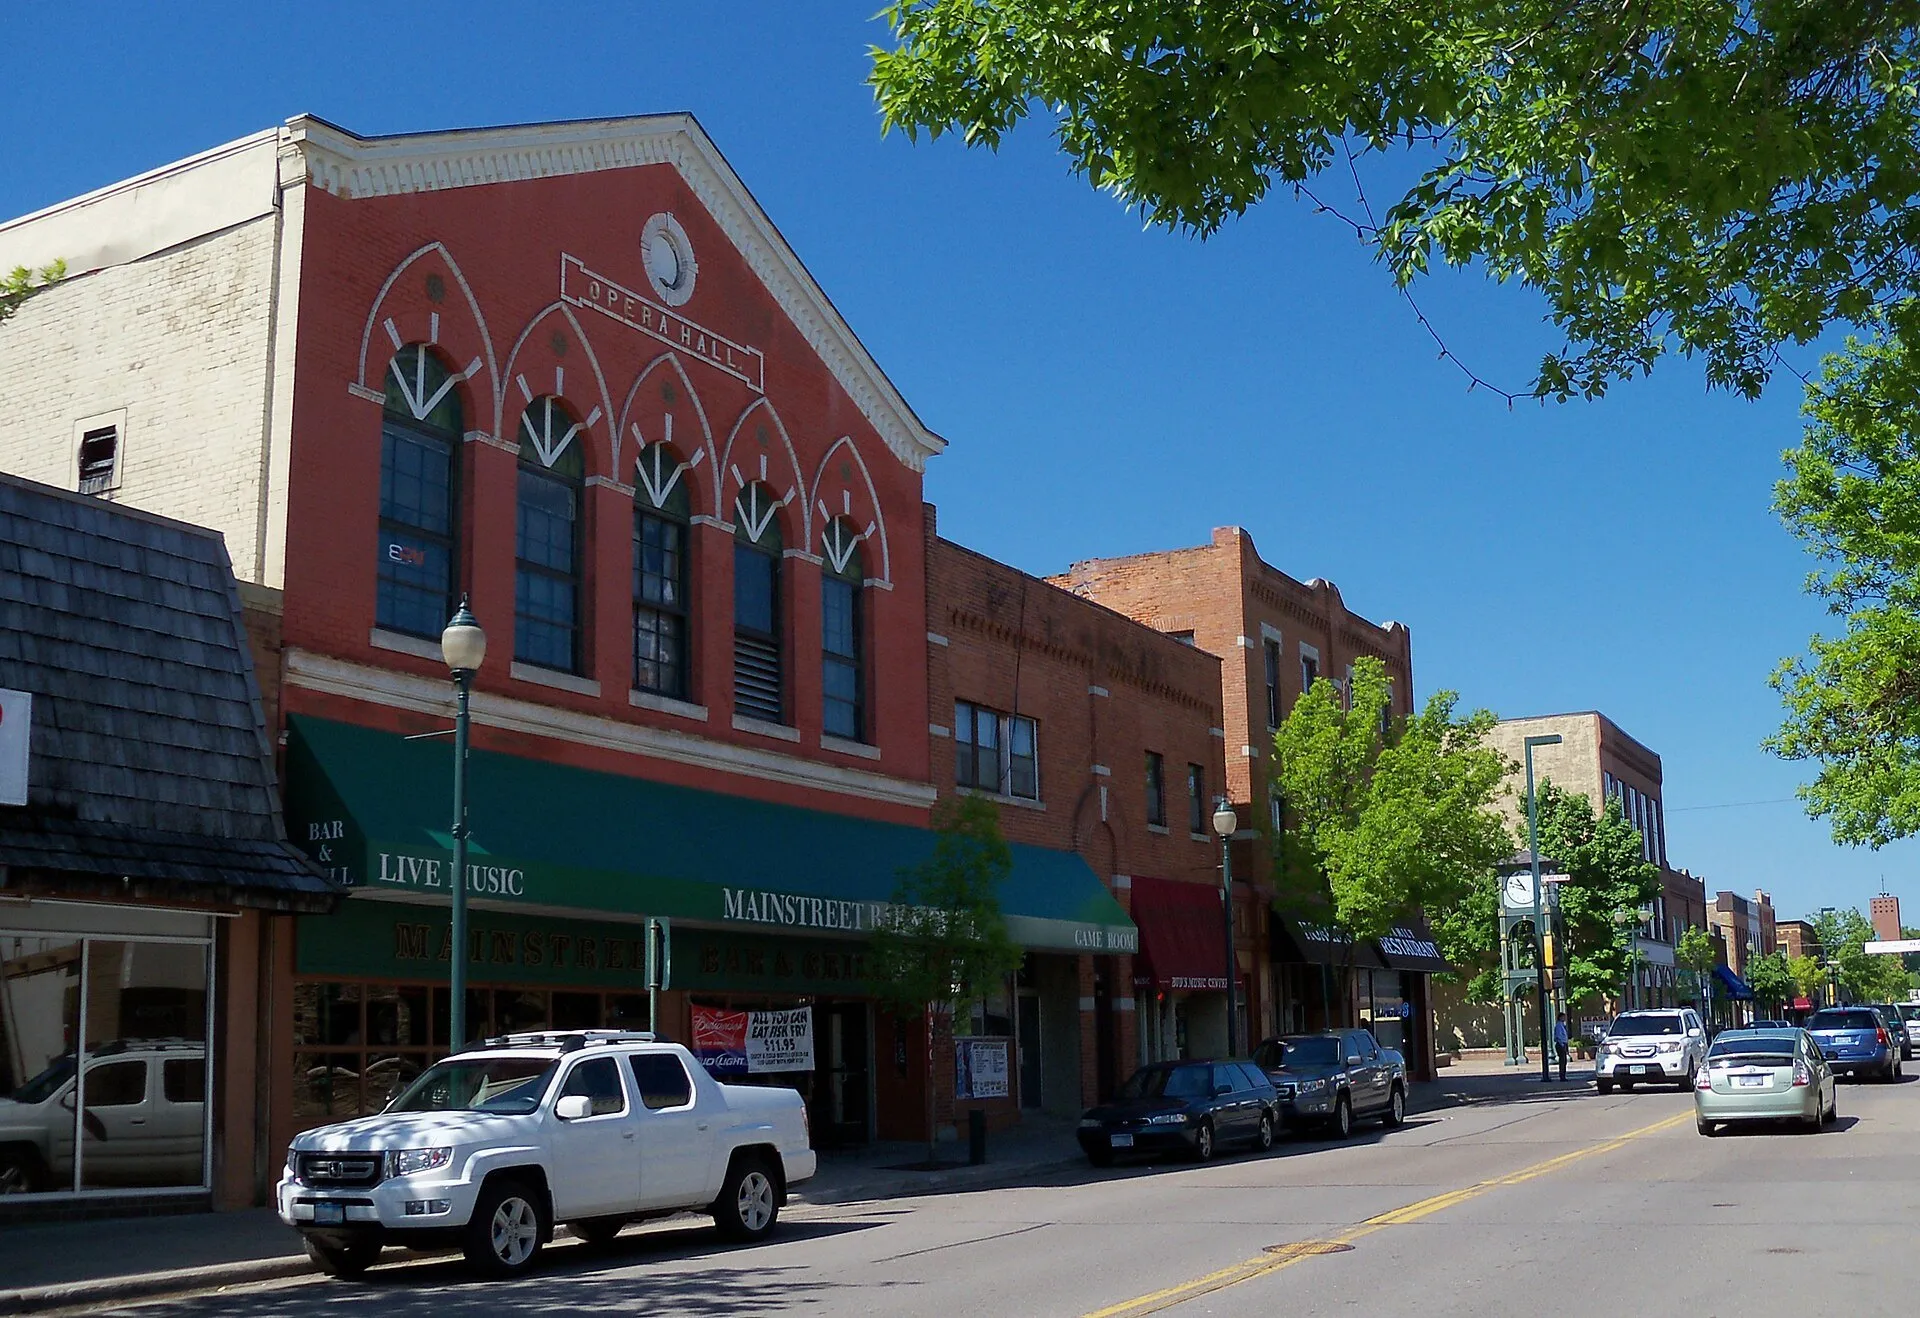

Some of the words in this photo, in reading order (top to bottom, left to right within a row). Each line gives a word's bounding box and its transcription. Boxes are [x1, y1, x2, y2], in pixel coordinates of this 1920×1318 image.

[589, 281, 668, 334] OPERA
[308, 820, 344, 841] BAR
[318, 843, 333, 862] &
[379, 853, 441, 887] LIVE
[722, 887, 865, 931] MAINSTREET
[1074, 929, 1103, 948] GAME
[1107, 932, 1135, 950] ROOM
[1379, 936, 1440, 959] RESTAURANT
[703, 943, 764, 976] BAR
[752, 1012, 769, 1025] ALL
[771, 1012, 789, 1024] YOU
[752, 1026, 770, 1038] EAT
[770, 1025, 788, 1037] FISH
[790, 1024, 806, 1037] FRY
[764, 1038, 795, 1051] $11.95
[718, 1056, 745, 1066] LIGHT
